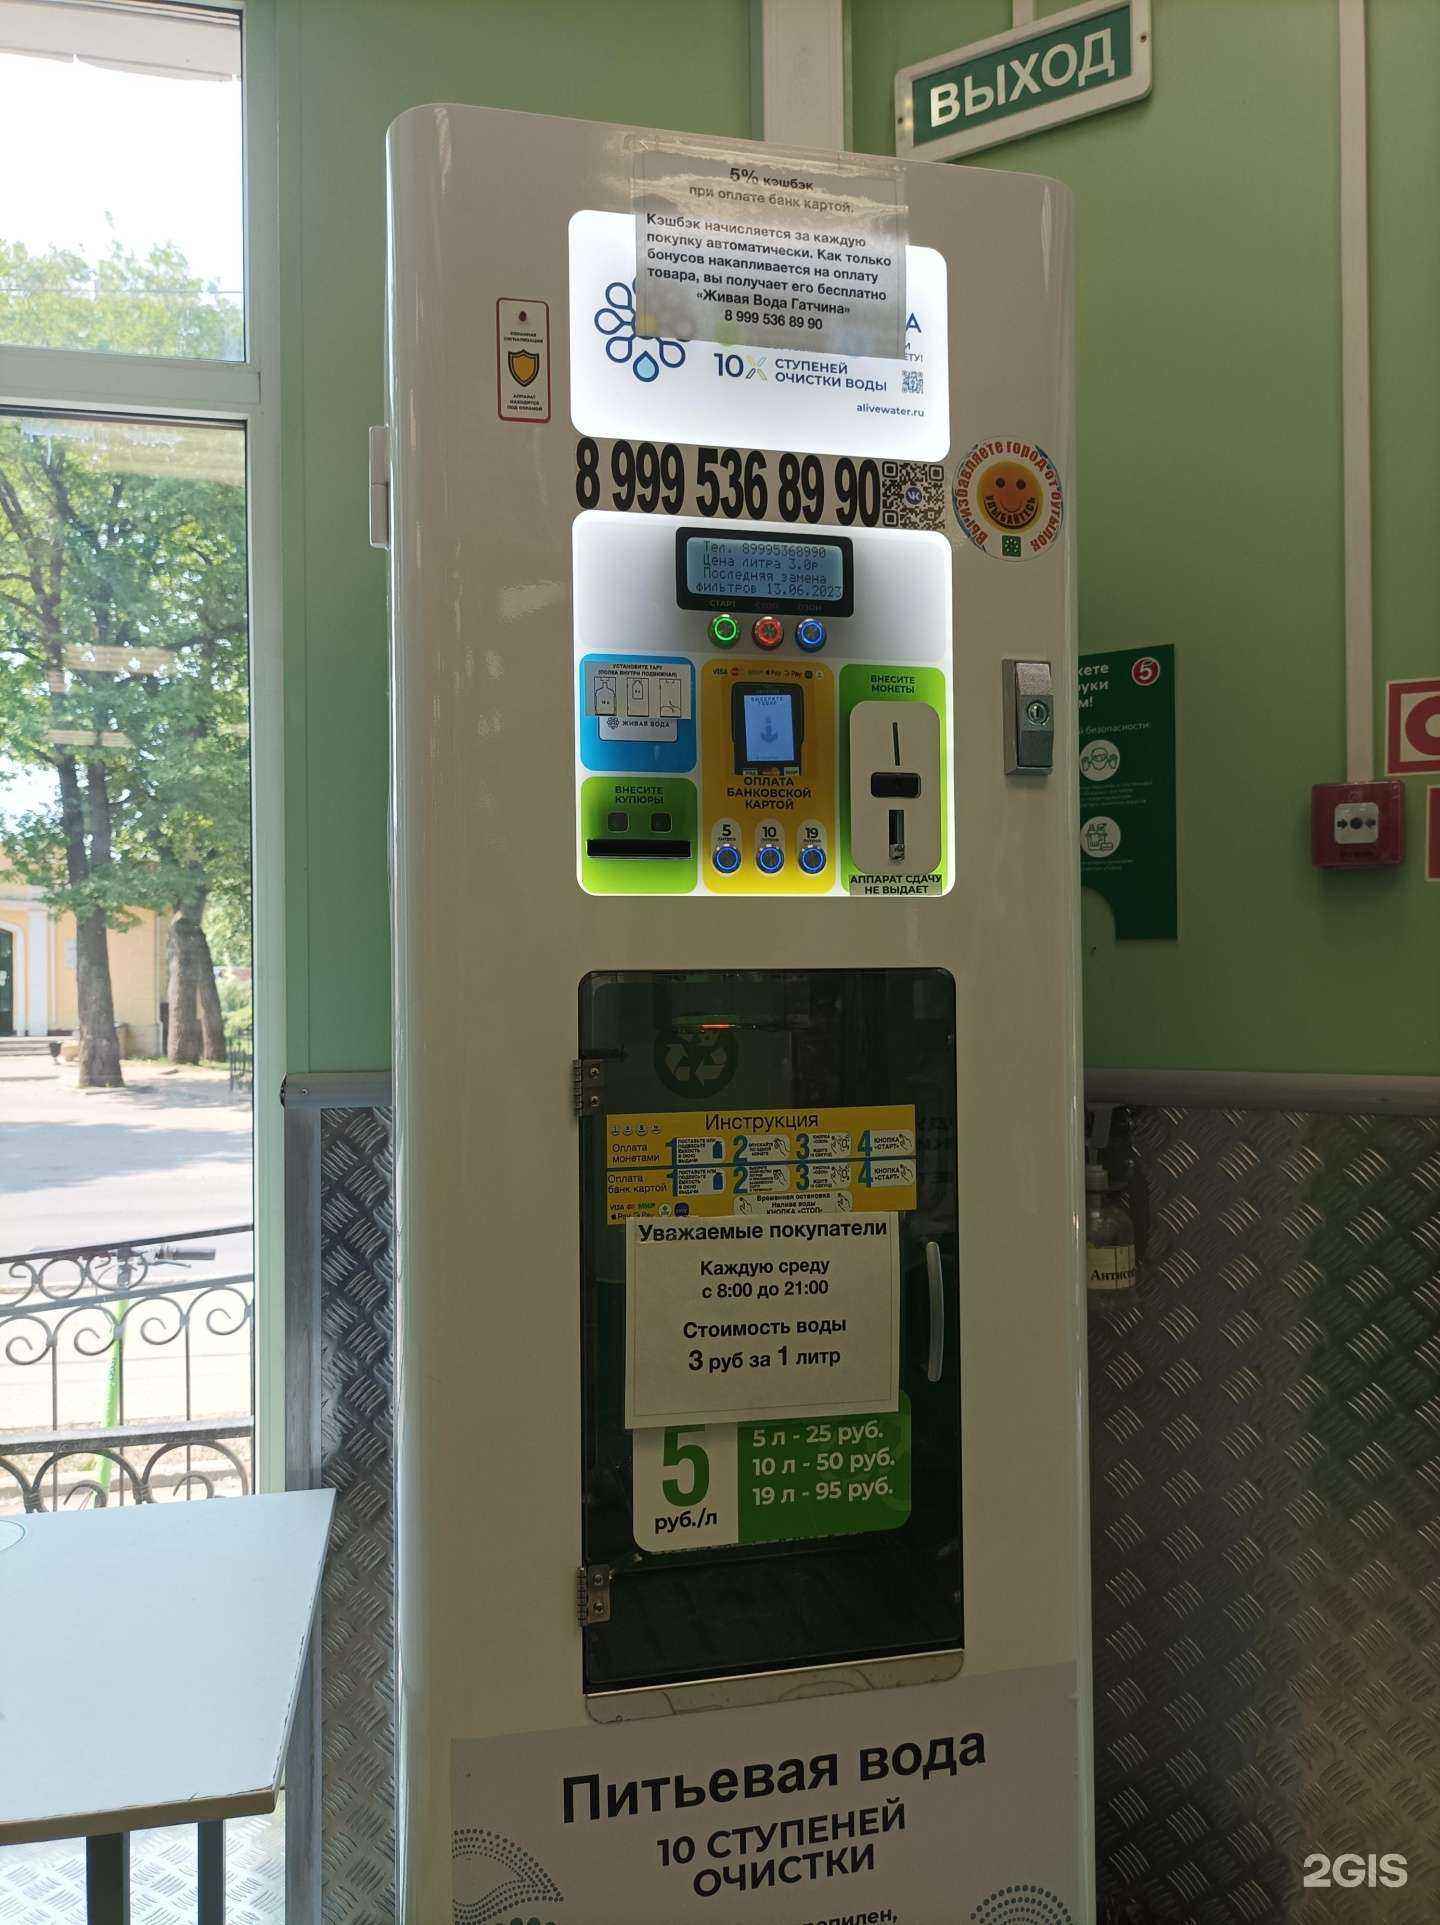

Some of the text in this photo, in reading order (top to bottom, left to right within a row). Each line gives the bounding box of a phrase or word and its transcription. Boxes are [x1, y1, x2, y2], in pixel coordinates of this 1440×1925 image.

[930, 27, 1115, 128] ВЫХОД
[729, 167, 814, 192] 5% кэшбэк
[689, 184, 714, 200] при
[718, 187, 766, 204] оплате
[769, 190, 800, 208] банк
[646, 213, 866, 249] Кэшбэк начисляется за каждую
[646, 232, 892, 268] покупку автоматически. Как только
[647, 248, 879, 285] бонусов накапливается на оплату
[647, 266, 887, 303] товара, вы получает его бесплатно
[696, 288, 851, 316] «Живая Вода Гатчина»
[724, 309, 823, 331] 8 999 536 89 90
[714, 353, 744, 378] 10
[775, 357, 848, 375] СТУПЕНЕЙ
[775, 374, 887, 392] ОЧИСТКИ ВОДЫ
[856, 402, 925, 418] alivewater.ru
[576, 437, 881, 528] 8 999 536 89 90
[704, 540, 732, 552] Тел.
[704, 554, 735, 568] Цена
[743, 557, 781, 570] литра
[704, 567, 828, 585] Последняя замена
[768, 584, 842, 599] 13.06.2023
[870, 675, 916, 685] ВНЕСИТЕ
[871, 684, 916, 694] МОНЕТЫ
[622, 720, 670, 729] ЖИВАЯ ВОДА
[615, 786, 664, 796] ВНЕСИТЕ
[744, 777, 794, 787] ОПЛАТА
[615, 795, 664, 806] КУПЮРЫ
[727, 787, 812, 799] БАНКОВСКОЙ
[745, 799, 794, 810] КАРТОЙ
[722, 824, 732, 837] 5
[762, 826, 777, 838] 10
[805, 827, 819, 839] 19
[850, 874, 942, 885] АППАРАТ СДАЧУ
[864, 885, 928, 896] НЕ ВЫДАЕТ
[705, 1113, 818, 1133] Инструкция
[612, 1143, 648, 1153] Оплата
[732, 1135, 748, 1164] 2
[795, 1133, 810, 1160] 3
[858, 1130, 873, 1158] 4
[874, 1137, 900, 1145] КНОПКА
[612, 1154, 660, 1164] монетами
[608, 1174, 644, 1184] Оплата
[732, 1165, 748, 1194] 2
[795, 1163, 810, 1191] 3
[858, 1161, 873, 1188] 4
[874, 1167, 900, 1175] КНОПКА
[608, 1186, 631, 1195] банк
[633, 1184, 668, 1195] картой
[795, 1192, 831, 1200] остановка
[638, 1221, 888, 1243] Уважаемые покупатели
[700, 1259, 830, 1278] Каждую среду
[702, 1280, 829, 1300] с 8:00 до 21:00
[683, 1318, 847, 1339] Стоимость воды
[688, 1346, 841, 1374] 3 руб за 1 литр
[753, 1430, 766, 1448] 5
[771, 1432, 786, 1447] л
[806, 1425, 832, 1443] 25
[838, 1421, 884, 1446] руб.
[662, 1424, 710, 1508] 5
[752, 1458, 776, 1476] 10
[781, 1461, 796, 1475] л
[816, 1453, 843, 1472] 50
[850, 1447, 896, 1474] руб.
[752, 1487, 776, 1506] 19
[780, 1489, 796, 1504] л
[815, 1482, 842, 1501] 95
[848, 1477, 893, 1503] руб.
[655, 1508, 718, 1534] руб./л
[562, 1731, 987, 1825] Питьевая вода
[656, 1797, 906, 1868] 10 СТУПЕНЕЙ
[692, 1844, 876, 1898] ОЧИСТКИ
